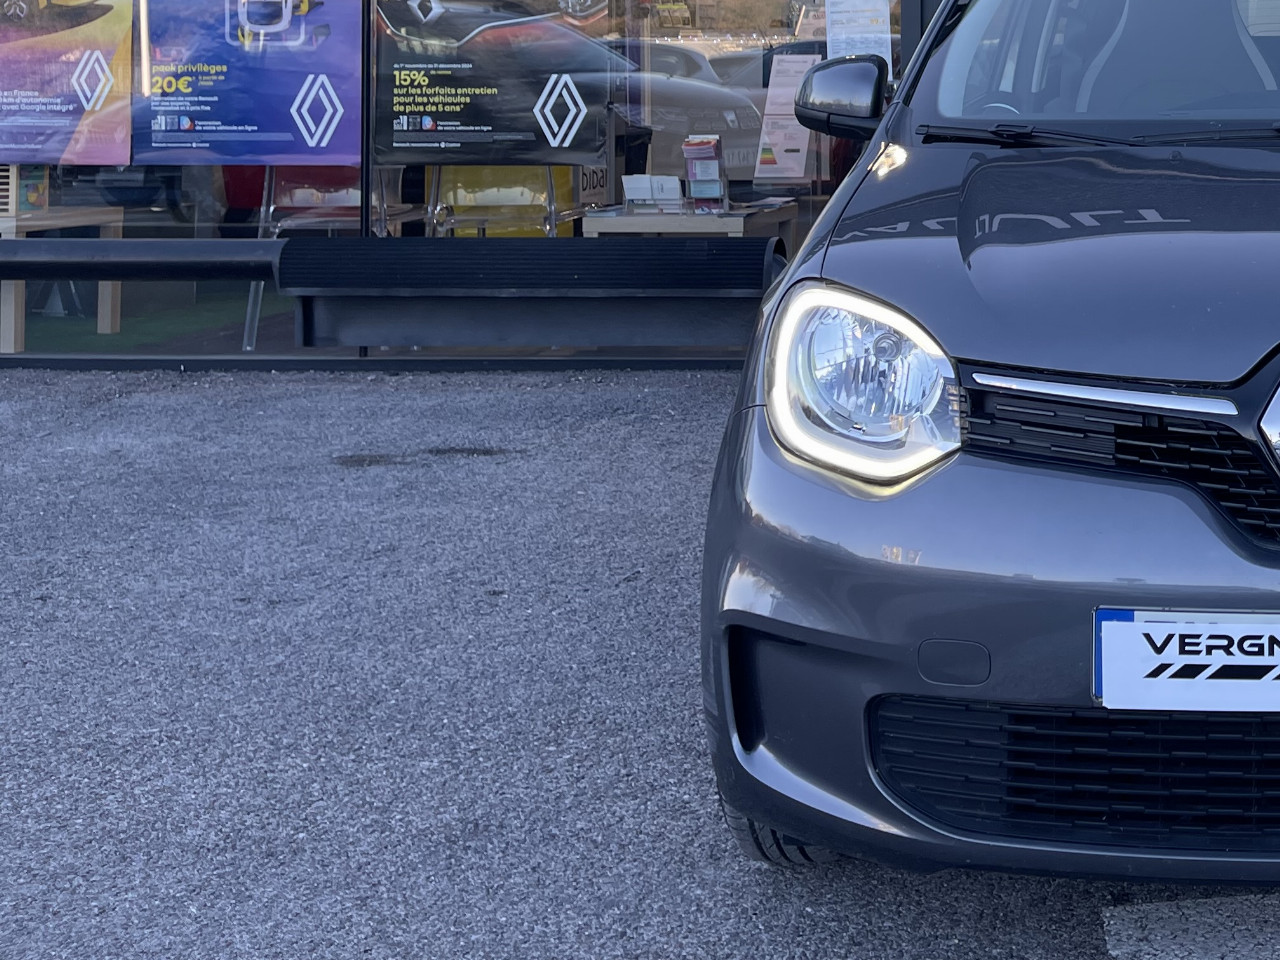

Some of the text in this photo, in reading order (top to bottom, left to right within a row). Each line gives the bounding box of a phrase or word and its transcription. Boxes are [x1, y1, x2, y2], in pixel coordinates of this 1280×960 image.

[393, 70, 429, 86] 15%
[393, 86, 498, 95] sur les forfaits entretien
[393, 95, 471, 104] pour les véhicules
[405, 103, 424, 113] plus
